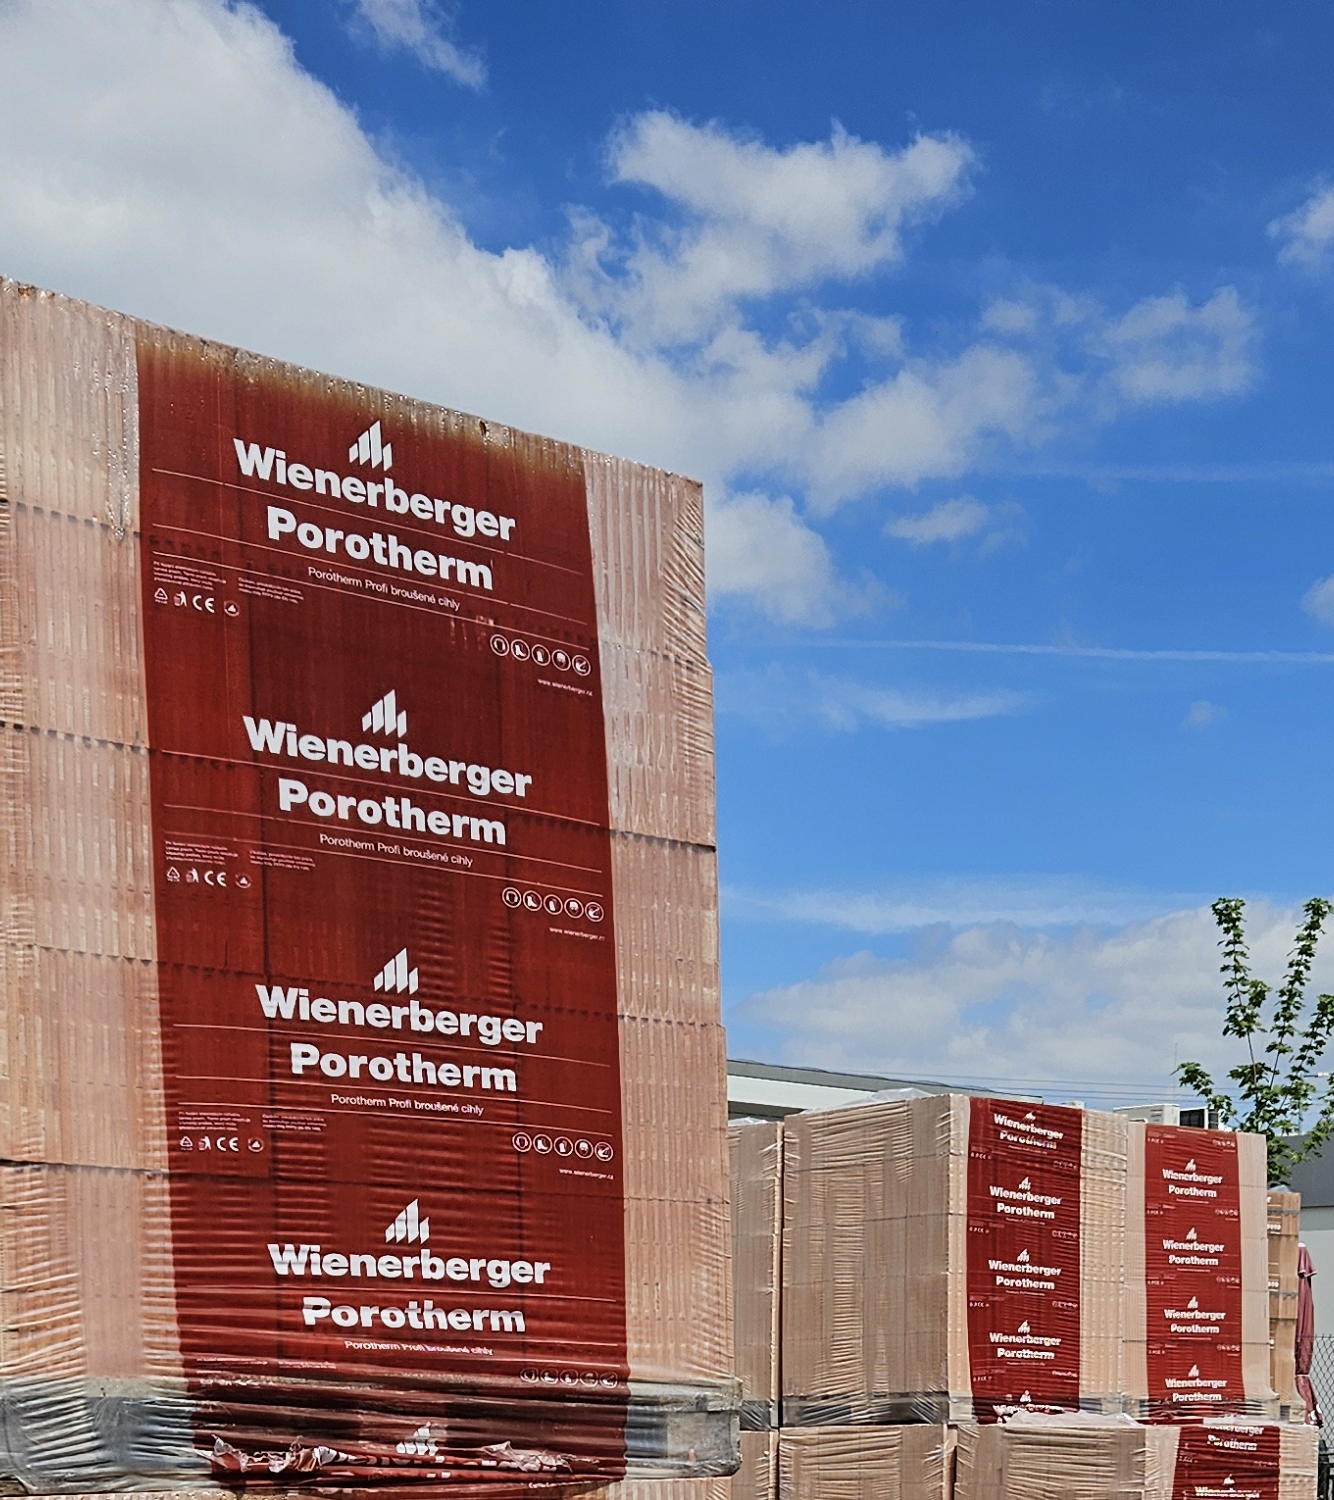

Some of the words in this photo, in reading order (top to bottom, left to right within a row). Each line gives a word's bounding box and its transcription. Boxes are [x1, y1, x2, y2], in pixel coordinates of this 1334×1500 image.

[233, 438, 516, 541] Wienerberger
[267, 506, 493, 590] Porotherm
[308, 566, 362, 589] Porotherm
[365, 579, 388, 594] Profi
[438, 596, 461, 611] cihly
[243, 715, 532, 798] Wienerberger
[278, 778, 506, 845] Porotherm
[320, 834, 374, 851] Porotherm
[377, 842, 401, 855] Profi
[451, 853, 473, 868] cihly
[255, 984, 543, 1046] Wienerberger
[290, 1042, 517, 1091] Porotherm
[331, 1094, 386, 1107] Porotherm
[389, 1098, 411, 1109] Profi
[461, 1104, 483, 1116] cihly
[994, 1113, 1063, 1139] Wienerberger
[1000, 1130, 1056, 1149] Porotherm
[1162, 1169, 1222, 1184] Wienerberger
[989, 1186, 1062, 1205] Wienerberger
[1168, 1185, 1217, 1197] Porotherm
[997, 1203, 1055, 1219] Porotherm
[1163, 1239, 1224, 1253] Wienerberger
[268, 1243, 550, 1287] Wienerberger
[988, 1260, 1061, 1276] Wienerberger
[1169, 1255, 1219, 1265] Porotherm
[996, 1275, 1055, 1289] Porotherm
[301, 1296, 525, 1333] Porotherm
[1164, 1309, 1226, 1321] Wienerberger
[1171, 1324, 1219, 1333] Porotherm
[989, 1332, 1061, 1346] Wienerberger
[997, 1348, 1055, 1359] Porotherm
[1165, 1378, 1227, 1389] Wienerberger
[1172, 1393, 1222, 1402] Porotherm
